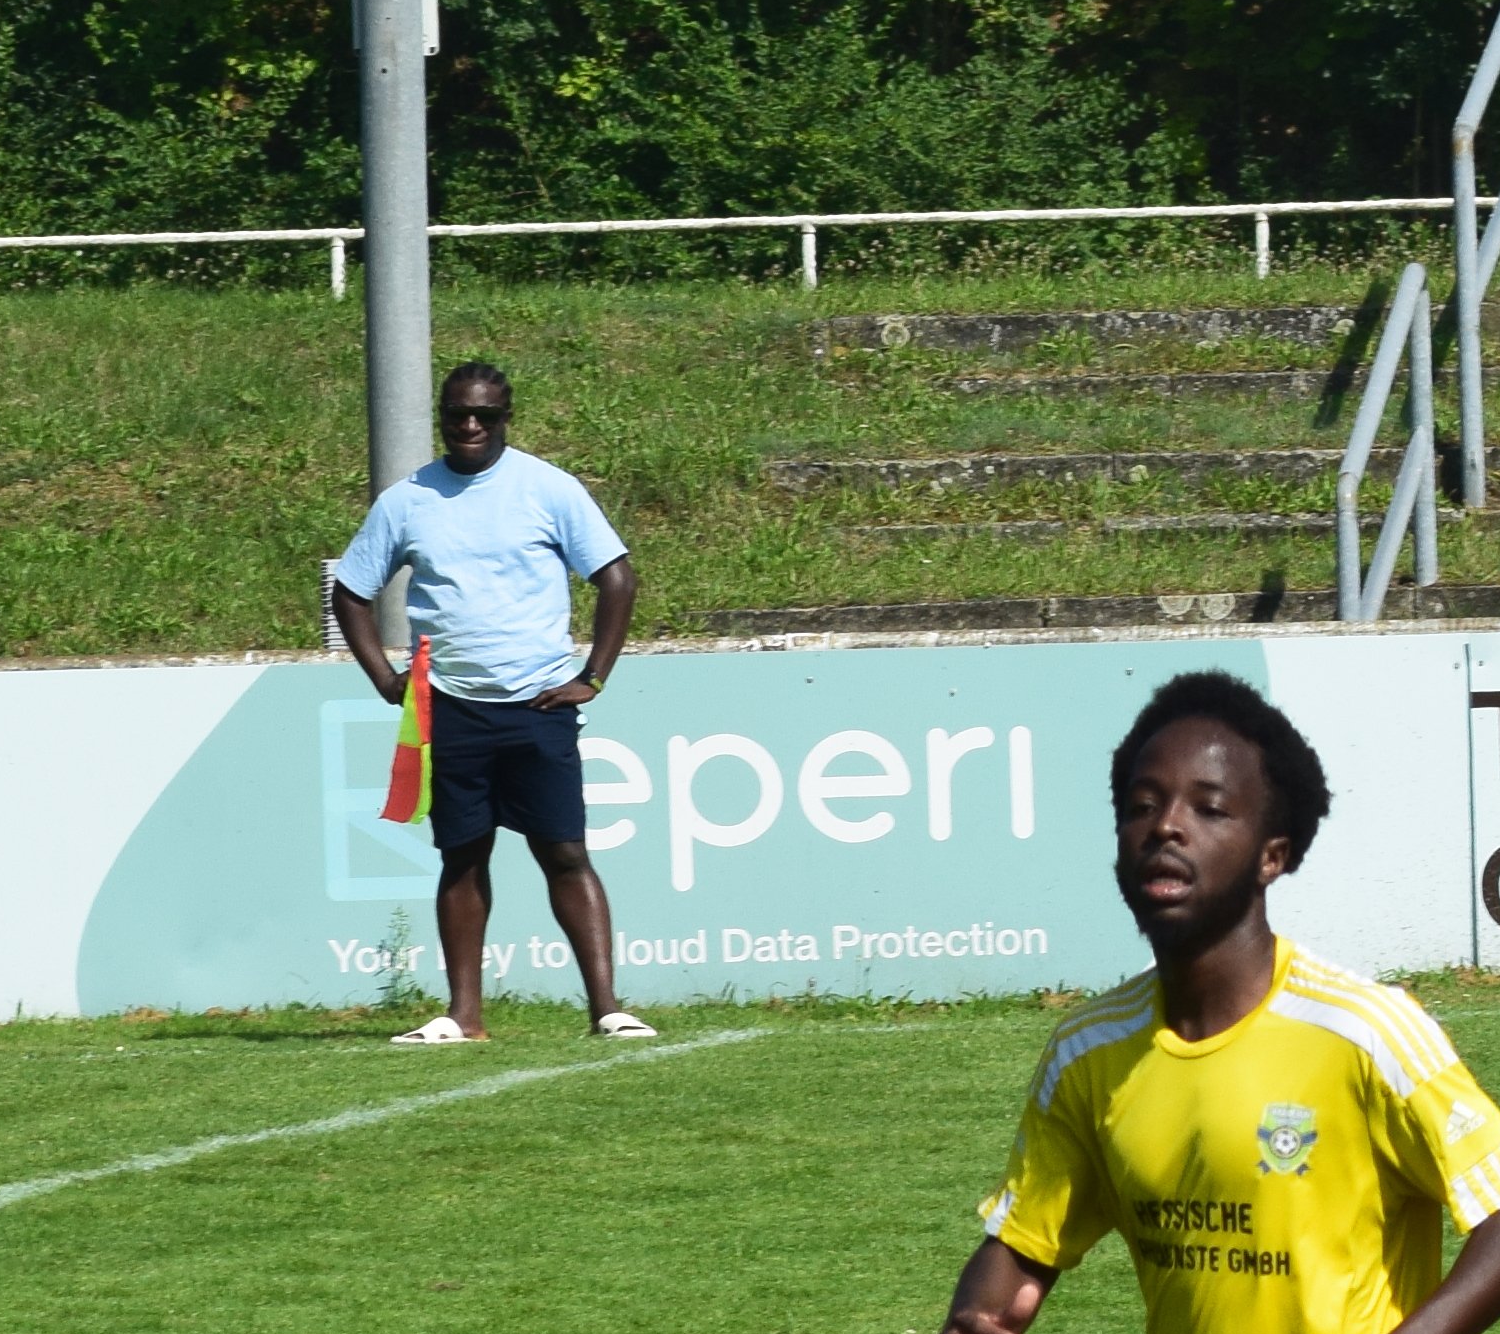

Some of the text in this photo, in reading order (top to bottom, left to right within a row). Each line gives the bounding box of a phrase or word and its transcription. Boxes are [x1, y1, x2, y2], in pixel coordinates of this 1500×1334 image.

[328, 939, 426, 973] Your
[528, 935, 569, 968] to
[617, 931, 707, 966] loud
[722, 928, 819, 963] Data
[832, 922, 1048, 960] Protection
[1133, 1199, 1253, 1234] HESSISCHE
[1227, 1248, 1290, 1276] GMBH
